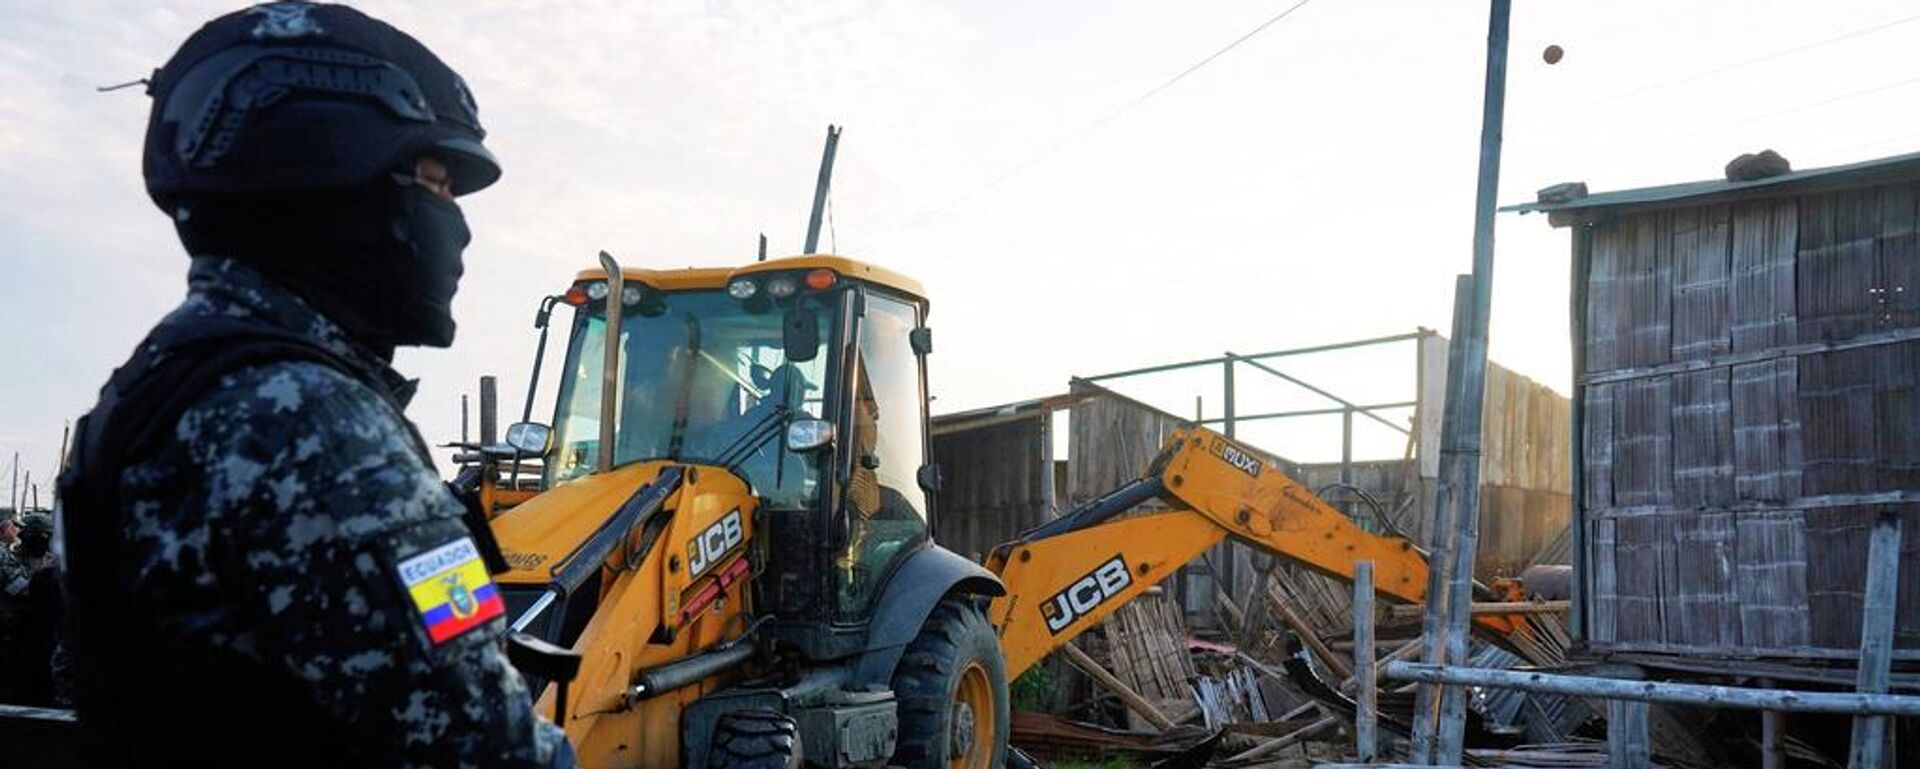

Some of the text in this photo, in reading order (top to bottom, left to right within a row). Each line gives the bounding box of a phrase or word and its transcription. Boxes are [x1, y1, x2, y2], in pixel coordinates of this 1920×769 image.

[403, 543, 472, 582] ECUADOR
[690, 510, 742, 575] JCB
[1048, 558, 1130, 631] JCB
